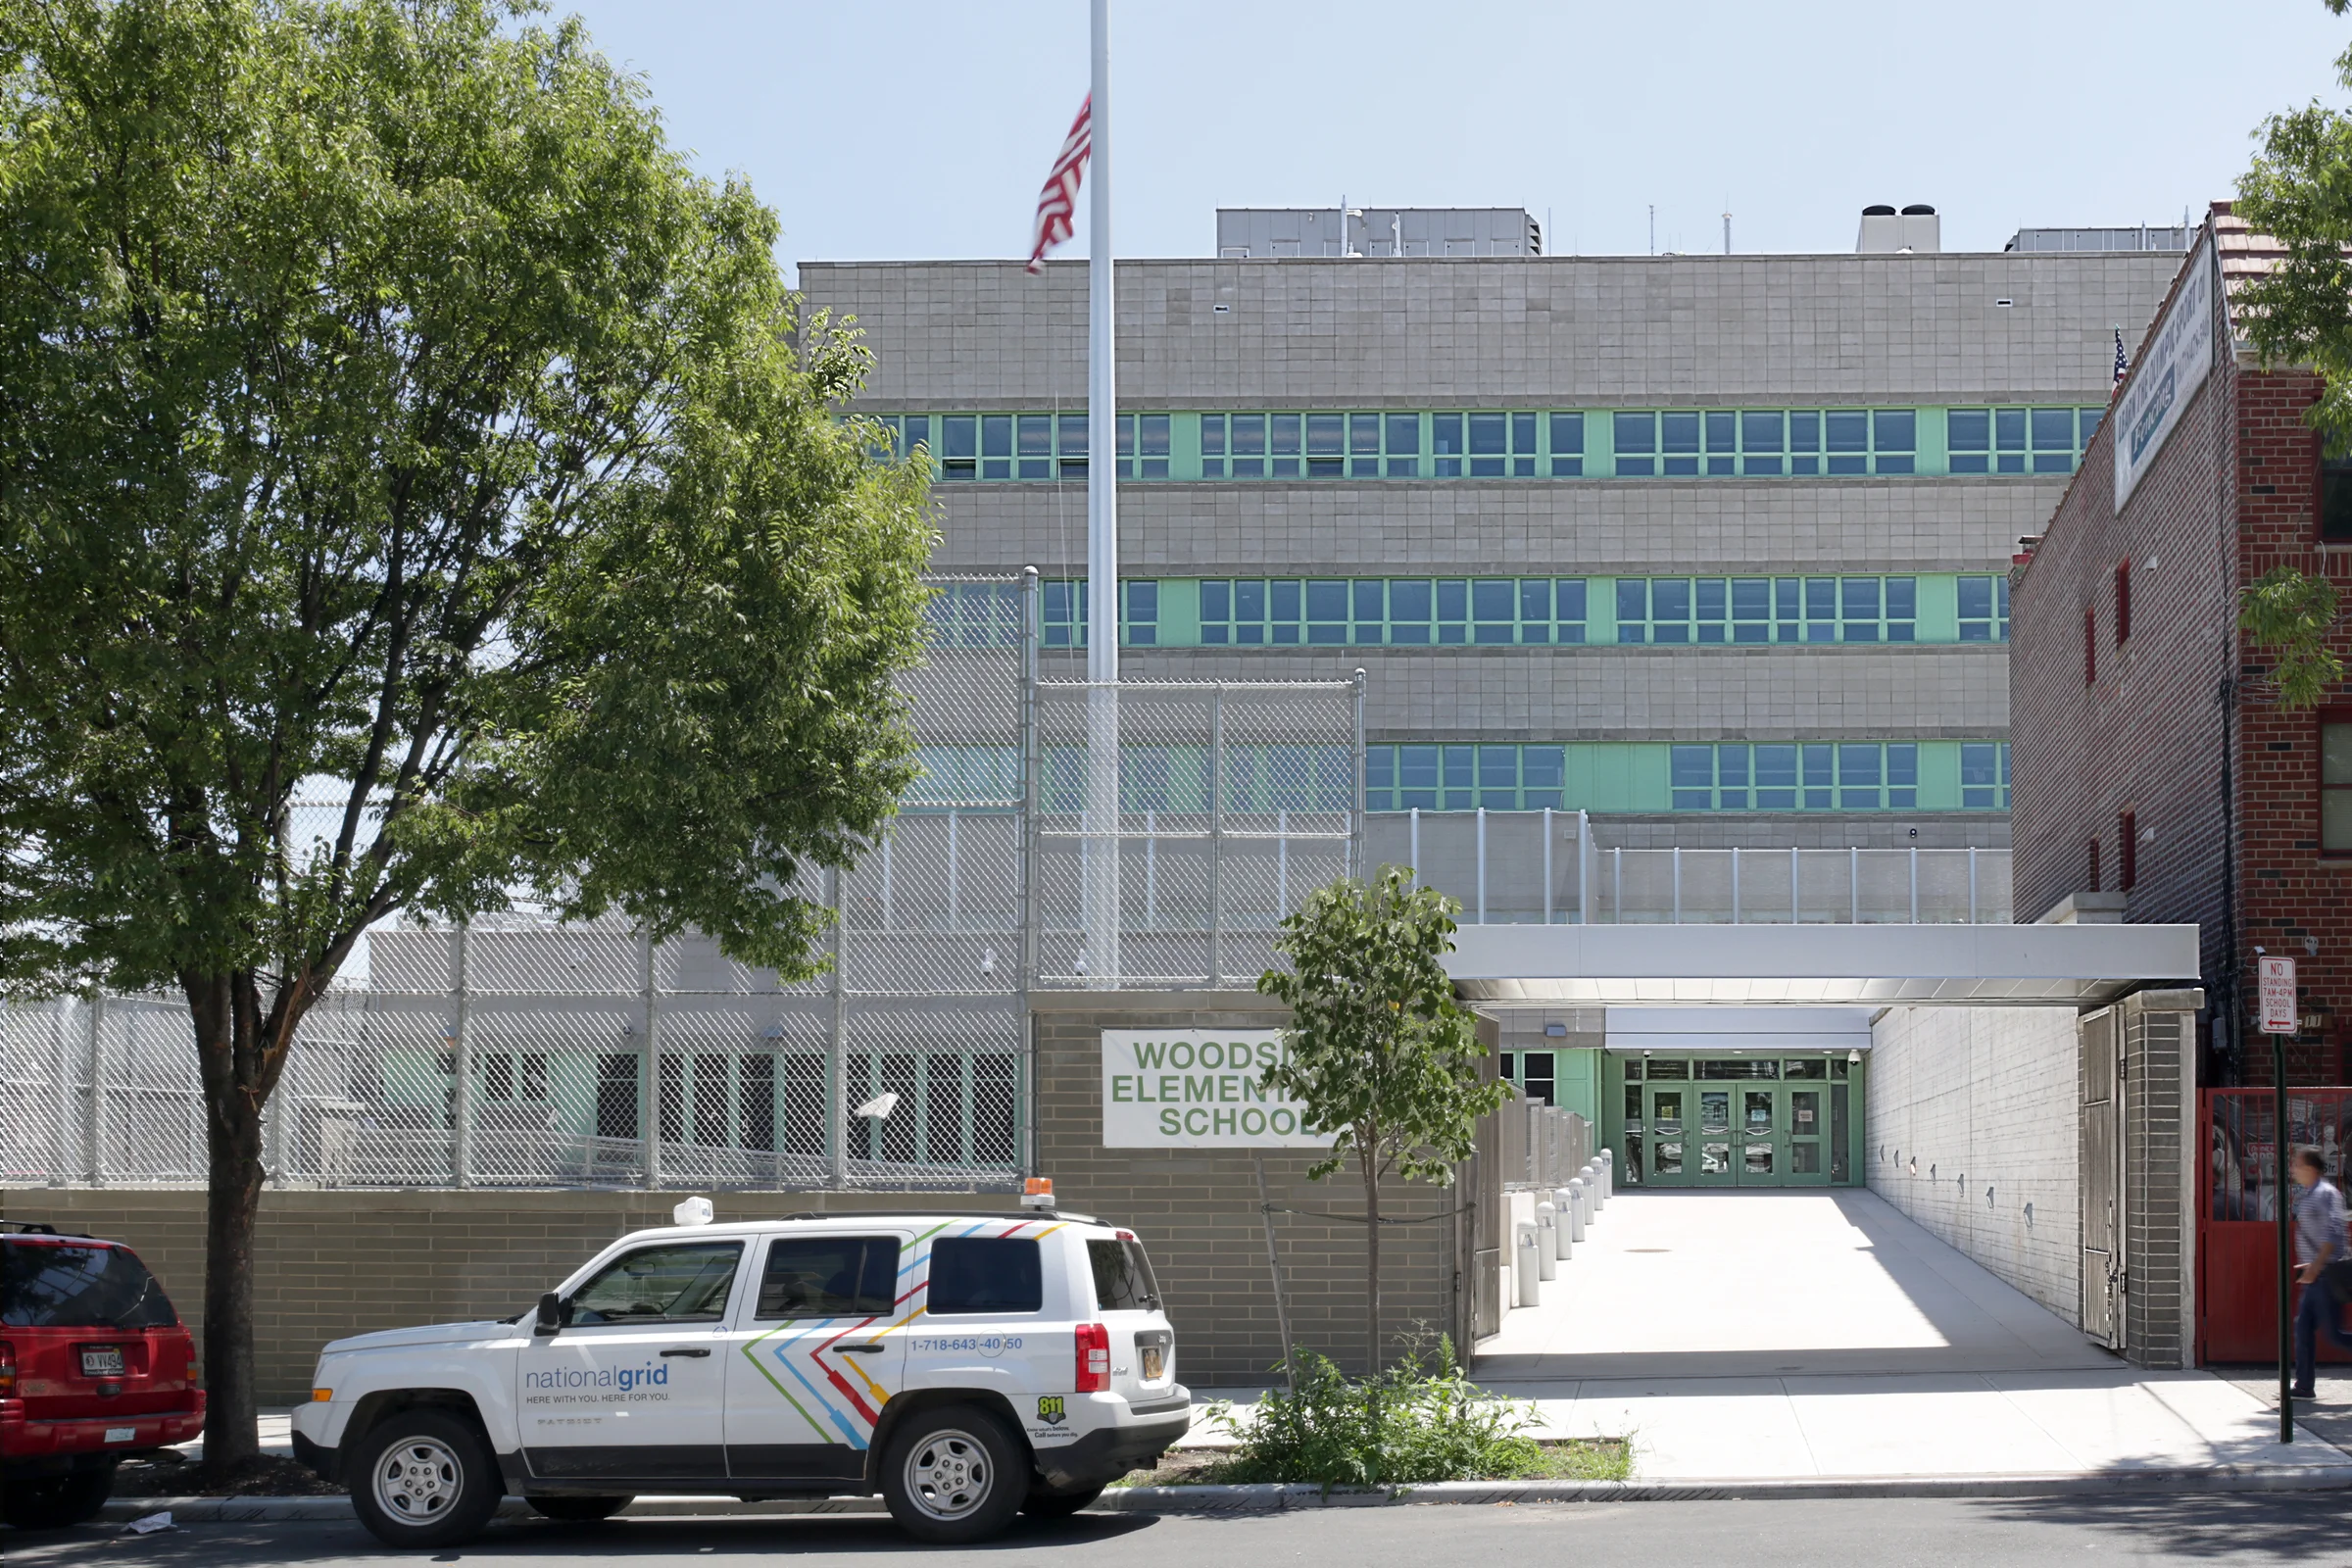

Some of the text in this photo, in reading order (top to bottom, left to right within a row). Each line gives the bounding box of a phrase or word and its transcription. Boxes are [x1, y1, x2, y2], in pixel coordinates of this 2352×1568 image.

[2176, 278, 2197, 345] SPORT
[2132, 375, 2172, 456] Fencing
[2270, 963, 2282, 976] NO
[2263, 977, 2292, 987] STANDING
[2263, 987, 2293, 998] 7AM-4PM
[2265, 998, 2290, 1007] SCHOOL
[2270, 1008, 2286, 1018] DAYS
[1133, 1041, 1290, 1070] WOODSI
[1111, 1074, 1286, 1103] ELEMEN
[1158, 1107, 1315, 1136] SCHOOL
[526, 1361, 667, 1392] nationalgrid
[1039, 1396, 1063, 1414] 811
